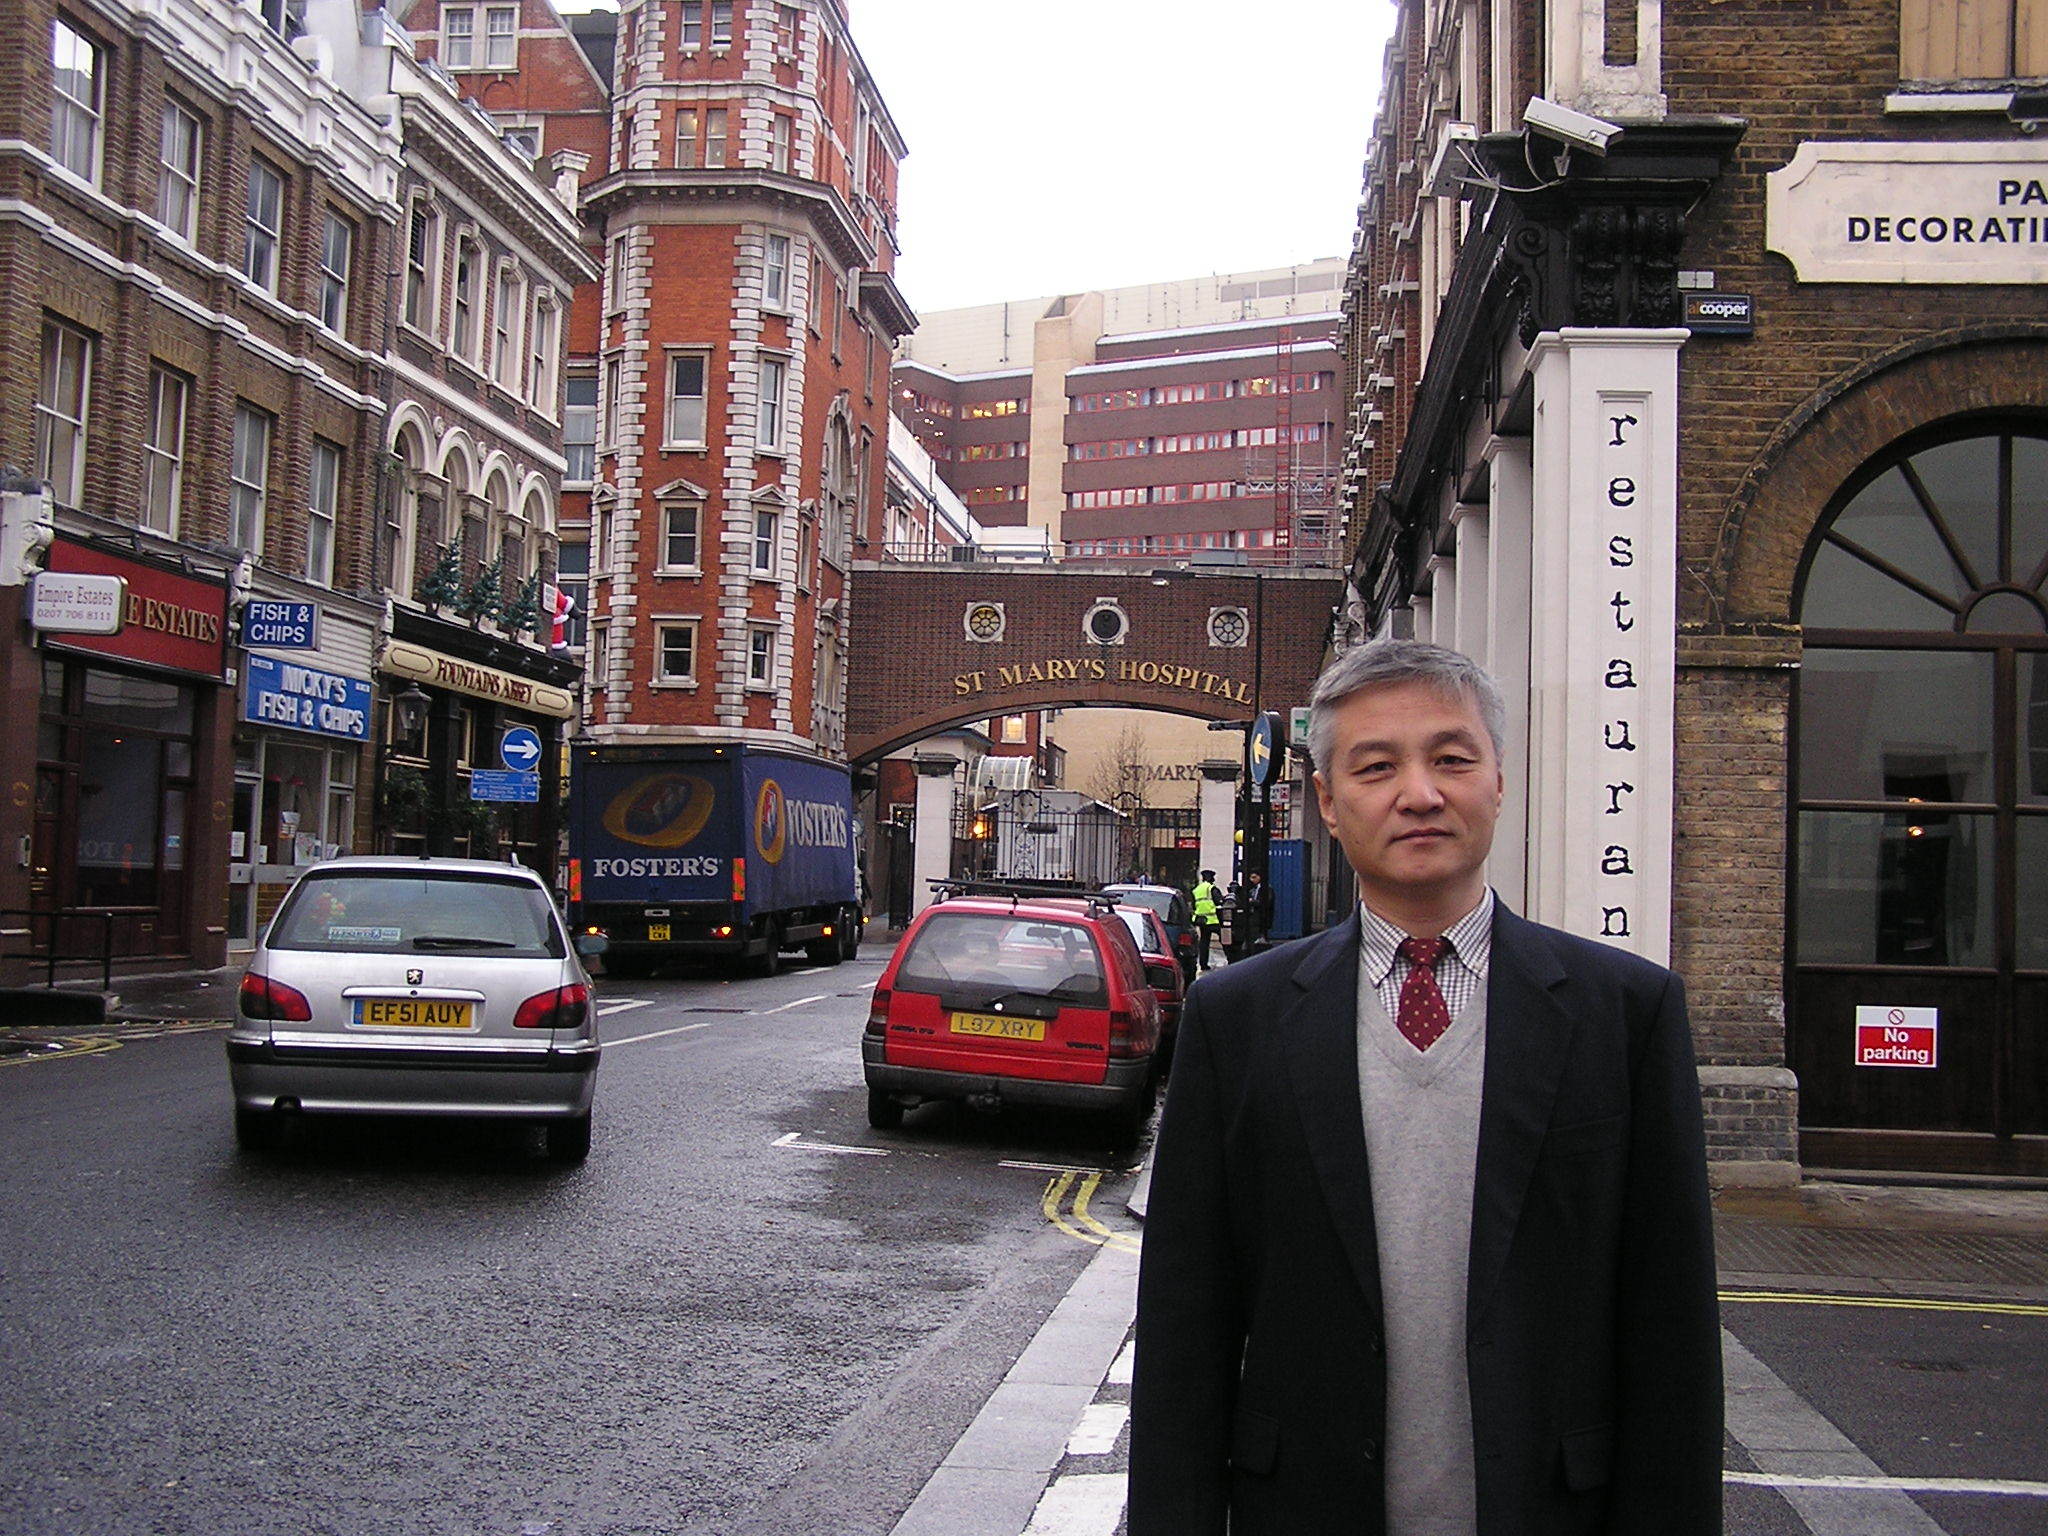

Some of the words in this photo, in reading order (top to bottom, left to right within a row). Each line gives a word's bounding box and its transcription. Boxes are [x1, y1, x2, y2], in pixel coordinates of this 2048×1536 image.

[38, 584, 73, 607] Empire
[77, 586, 113, 606] Estates
[143, 597, 219, 643] ESTATES
[250, 603, 290, 621] FISH
[297, 605, 310, 623] &
[250, 624, 306, 643] CHIPS
[281, 664, 347, 703] NICKY'S
[435, 657, 500, 696] FOUNTAINS
[955, 671, 985, 695] ST
[1000, 659, 1106, 687] MARY'S
[1120, 661, 1252, 705] HOSPITAL
[258, 690, 298, 723] FISH
[301, 699, 314, 726] &
[319, 703, 364, 735] CHIPS
[1122, 765, 1143, 781] ST
[785, 800, 848, 849] FOSTER'S
[593, 855, 719, 877] FOSTER'S
[371, 1003, 418, 1022] EF51
[425, 1004, 465, 1024] AUY
[1000, 1019, 1036, 1038] XRY
[1884, 1028, 1909, 1043] No
[1863, 1046, 1928, 1063] parking
